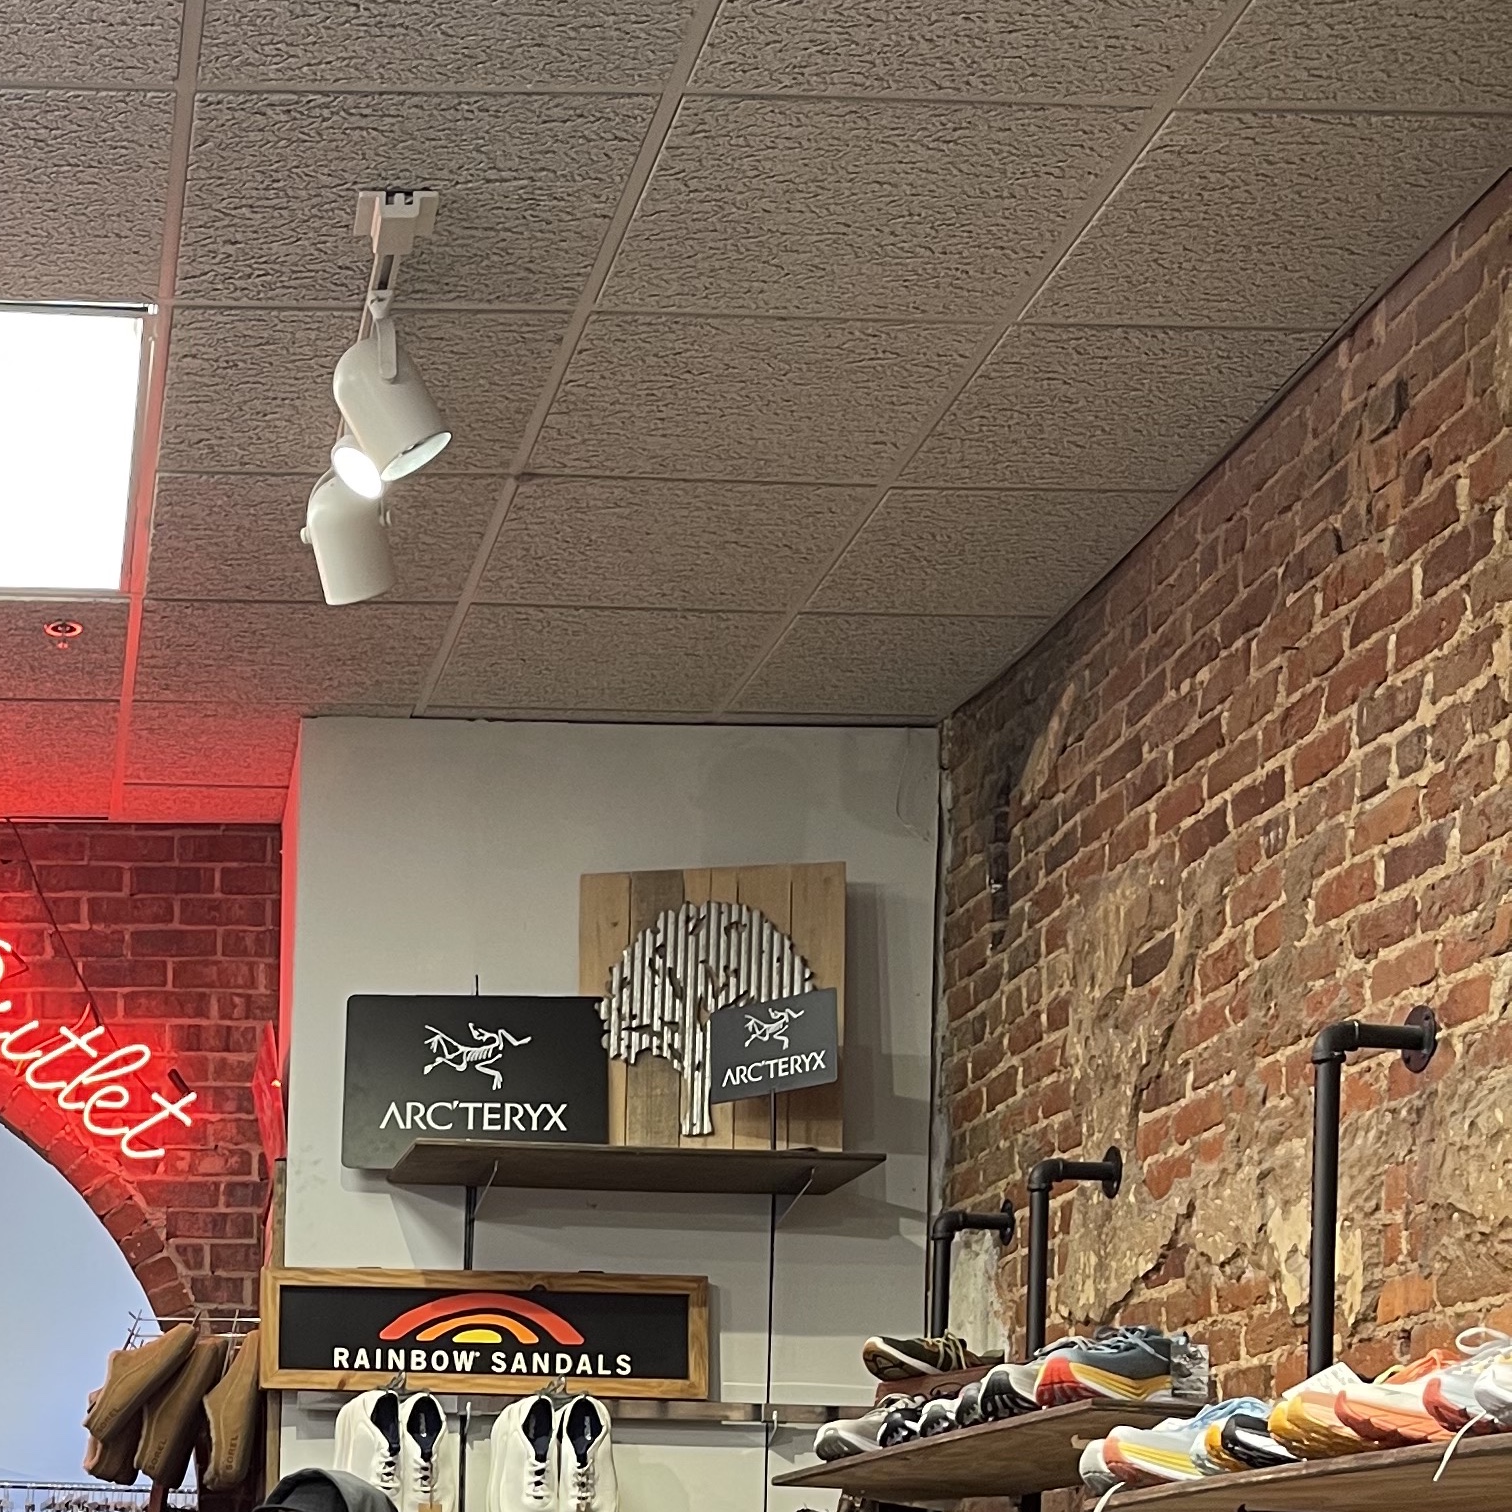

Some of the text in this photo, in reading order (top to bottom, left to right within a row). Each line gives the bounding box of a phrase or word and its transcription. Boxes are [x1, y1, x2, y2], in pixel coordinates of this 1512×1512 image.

[721, 1049, 827, 1088] ARC'TERYX
[379, 1100, 568, 1133] ARC'TERYX
[333, 1346, 633, 1377] RAINBOW SANDALS
[148, 1438, 168, 1471] SOREL
[226, 1434, 239, 1471] SOREL
